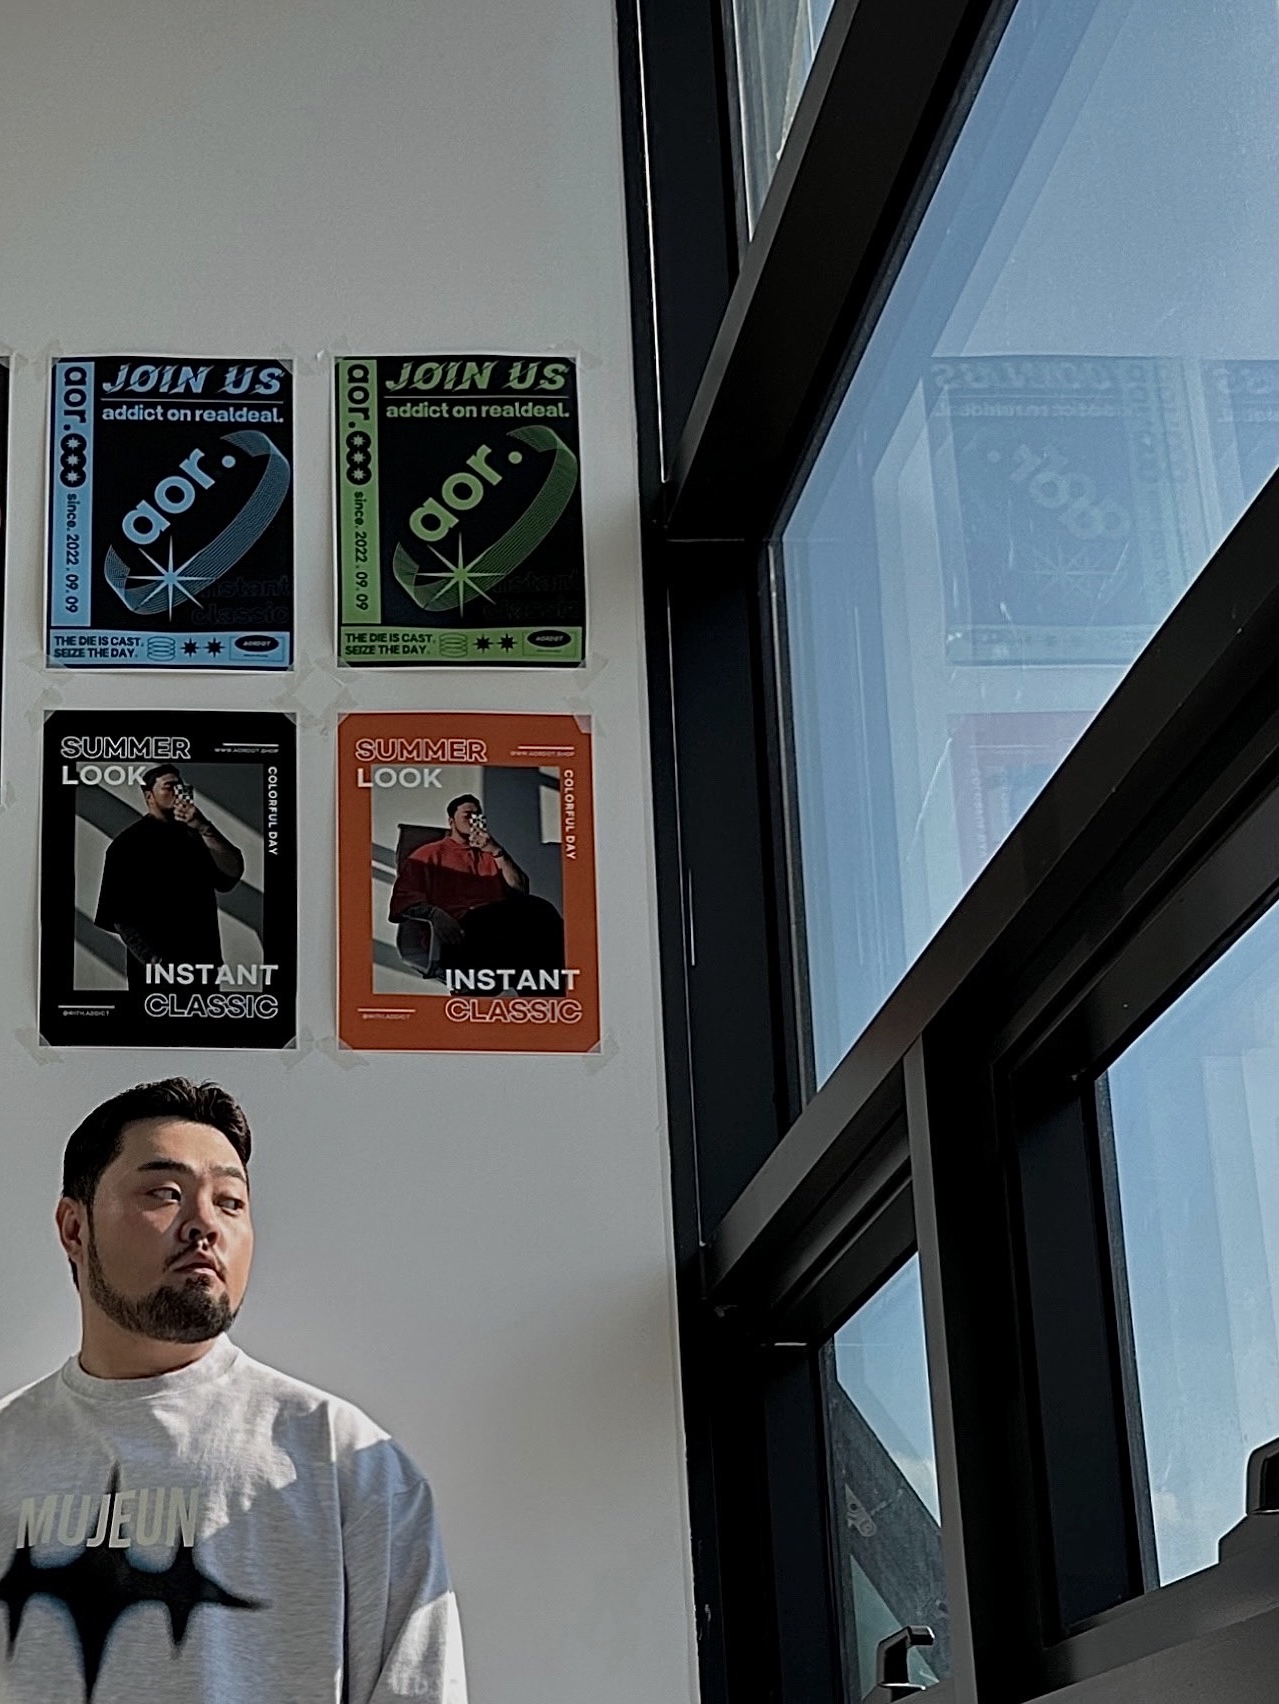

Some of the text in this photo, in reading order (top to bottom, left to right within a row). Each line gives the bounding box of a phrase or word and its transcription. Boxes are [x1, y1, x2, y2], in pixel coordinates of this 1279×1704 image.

[102, 363, 285, 395] JOIN US
[385, 360, 570, 392] JOIN US
[63, 367, 87, 431] aor.
[347, 364, 370, 429] aor.
[102, 404, 284, 423] addict on realdeal.
[386, 402, 570, 418] addict on realdeal.
[54, 636, 144, 647] THE DIE IS CAST.
[345, 633, 436, 644] THE DIE IS CAST.
[345, 645, 430, 655] SEIZE THE DAY.
[54, 648, 138, 658] SEIZE THE DAY.
[61, 736, 191, 760] SUMMER
[355, 738, 488, 762] SUMMER
[62, 765, 147, 786] LOOK
[356, 767, 443, 789] LOOK
[267, 766, 278, 856] COLORFUL DAY
[563, 769, 577, 860] COLORFUL DAY
[145, 963, 279, 986] INSTANT
[445, 969, 581, 990] INSTANT
[144, 992, 279, 1019] CLASSIC
[445, 998, 583, 1024] CLASSIC
[17, 1487, 200, 1549] MUJEUN
